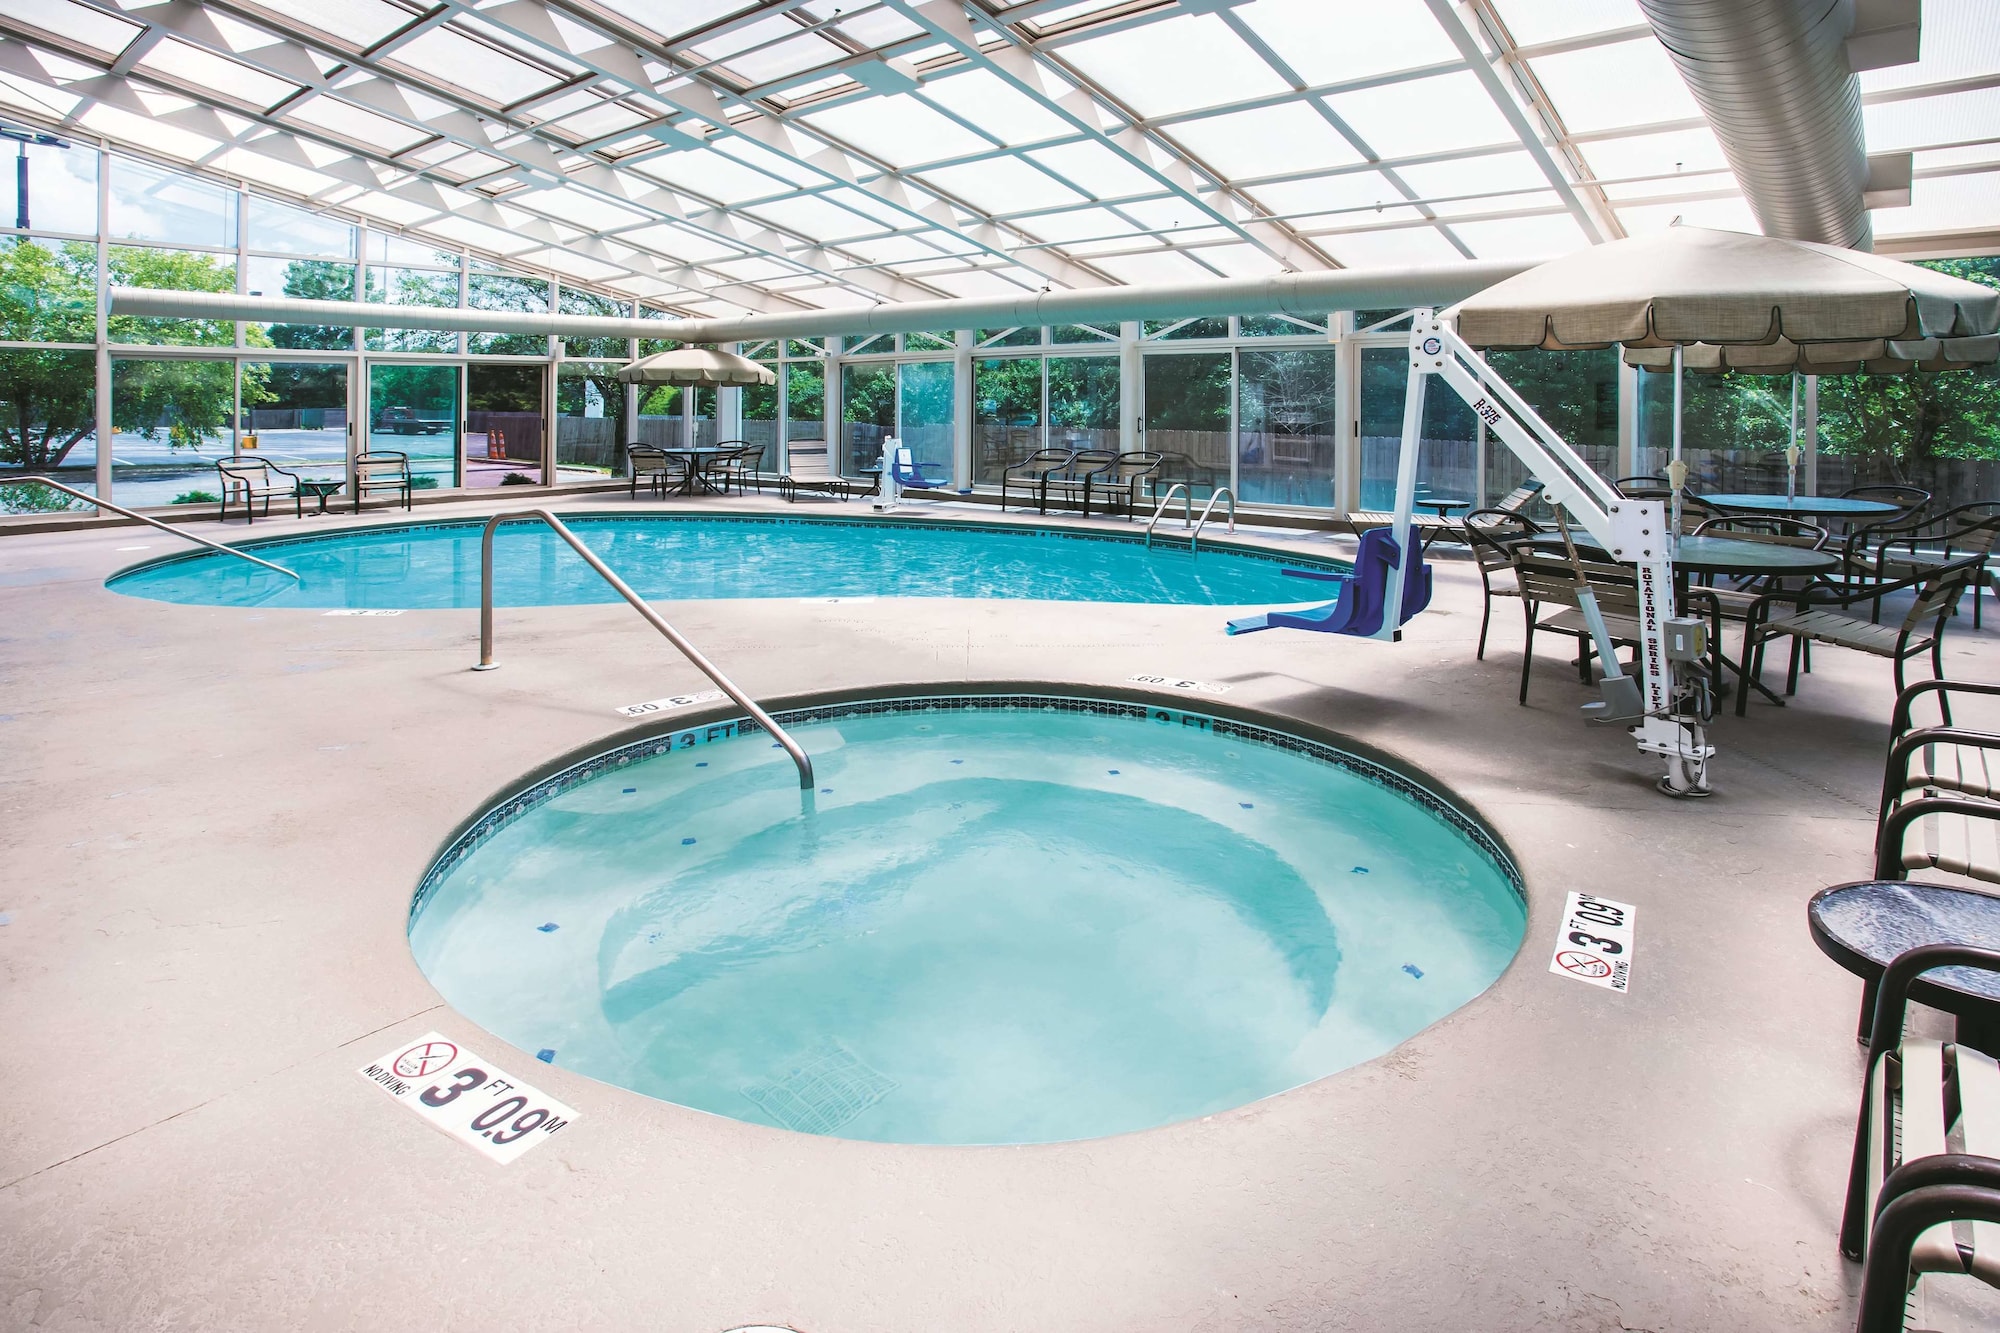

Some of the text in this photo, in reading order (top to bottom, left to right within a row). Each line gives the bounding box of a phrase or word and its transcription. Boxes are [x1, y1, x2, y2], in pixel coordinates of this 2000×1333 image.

[1642, 567, 1662, 710] ROTATIONAL SERIES LIFT
[707, 723, 736, 743] FT
[1569, 919, 1588, 931] FT
[1575, 901, 1625, 927] 0.9
[1568, 931, 1623, 955] 3
[1611, 961, 1629, 991] NO DIVING
[363, 1064, 383, 1077] NO
[374, 1072, 411, 1096] DIVING
[419, 1067, 569, 1145] 3 FT 0.9 M
